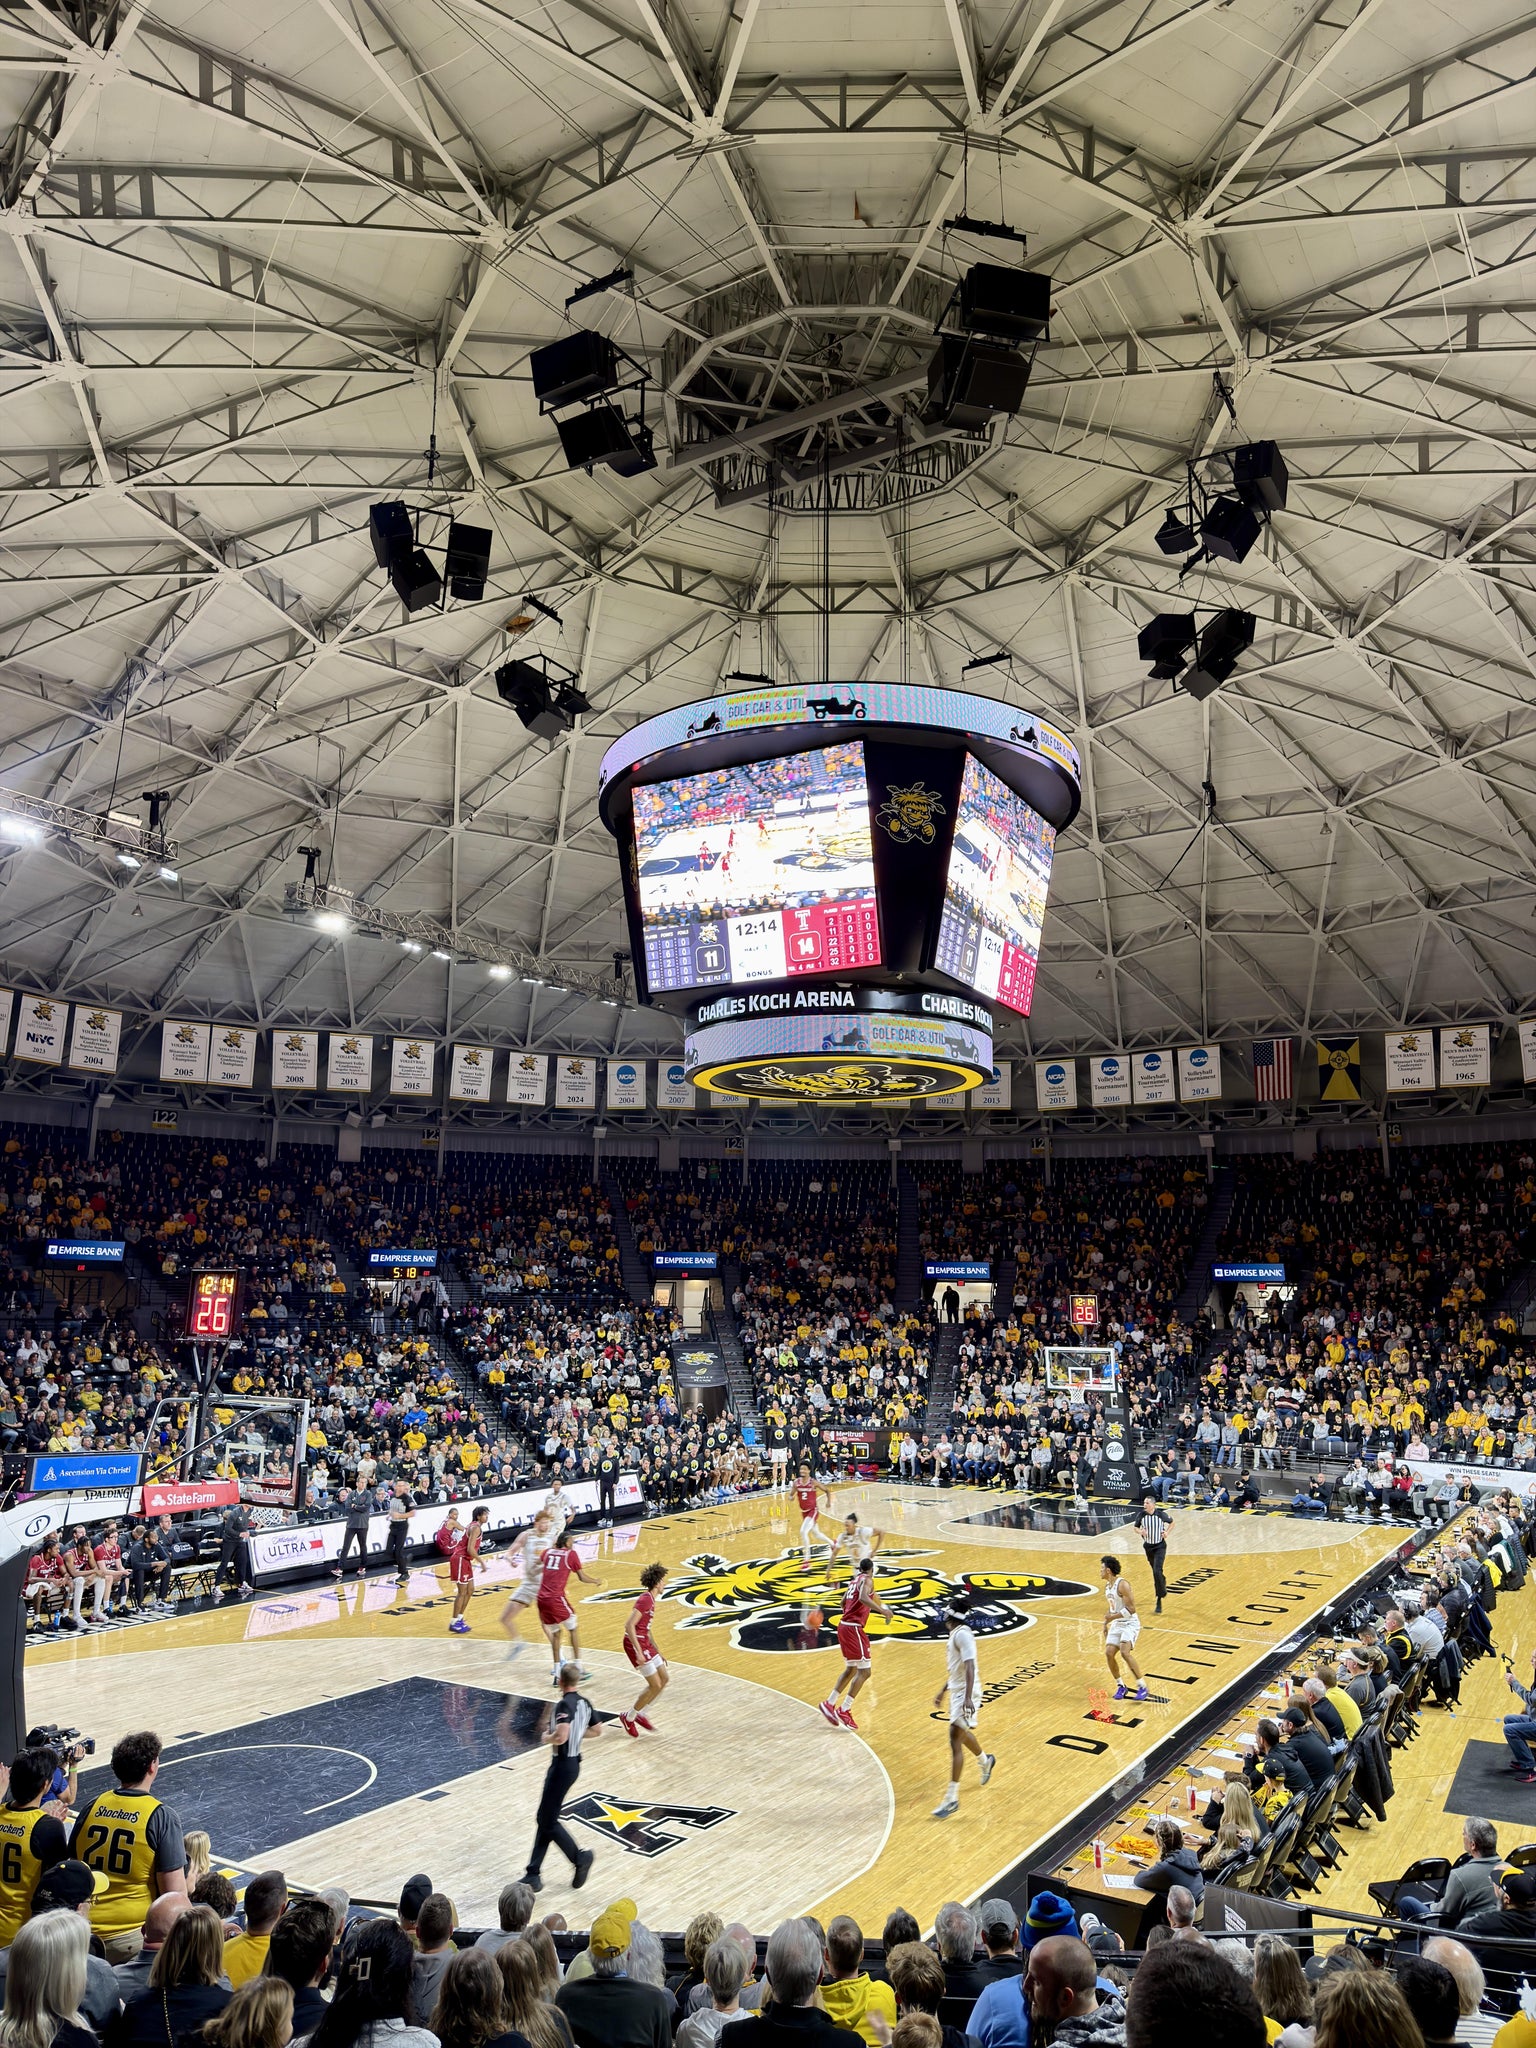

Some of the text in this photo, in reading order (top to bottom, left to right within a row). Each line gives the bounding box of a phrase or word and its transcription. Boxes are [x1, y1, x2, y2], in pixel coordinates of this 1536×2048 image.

[729, 706, 751, 718] GOLF
[752, 701, 771, 714] CAR
[777, 700, 783, 711] &
[828, 911, 870, 926] 2 0 0
[735, 919, 778, 937] 12:14
[848, 924, 853, 933] 0
[866, 921, 871, 930] 0
[828, 937, 838, 946] 22
[848, 934, 854, 944] 5
[867, 932, 872, 941] 0
[829, 942, 873, 956] 25 0 0
[984, 936, 1001, 954] 12:14
[704, 950, 718, 968] 11
[830, 952, 874, 966] 32 4 0
[746, 968, 773, 978] BONUS
[698, 990, 855, 1022] CHARLES KOCH ARENA
[922, 994, 974, 1020] CHARLES
[82, 1028, 111, 1037] VOLLEYBALL
[873, 1027, 896, 1040] GOLF
[898, 1028, 916, 1042] CAR
[918, 1030, 926, 1043] &
[83, 1056, 104, 1066] 2004
[174, 1068, 194, 1076] 2005
[221, 1072, 240, 1080] 2007
[1188, 1069, 1213, 1077] Volleyball
[1455, 1072, 1475, 1080] 1965
[340, 1078, 358, 1086] 2013
[1098, 1075, 1124, 1083] Volleyball
[1402, 1078, 1420, 1086] 1964
[462, 1088, 478, 1096] 2016
[1192, 1088, 1210, 1096] 2024
[154, 1110, 177, 1122] 122
[726, 1138, 744, 1148] 124
[58, 1246, 121, 1256] EMPRISE BANK
[380, 1254, 434, 1262] EMPRISE BANK
[393, 1267, 416, 1278] 5:18
[936, 1266, 966, 1274] EMPRISE
[1224, 1268, 1282, 1277] EMPRISE BANK
[199, 1276, 234, 1294] 12:14
[1076, 1298, 1095, 1306] 12:14
[197, 1298, 228, 1331] 26
[1076, 1306, 1093, 1320] 26
[1107, 1446, 1123, 1454] Pella
[60, 1469, 94, 1477] Ascension
[108, 1466, 132, 1474] Christi
[1449, 1468, 1462, 1476] WIN
[84, 1488, 130, 1502] SPALDING
[802, 1492, 808, 1500] 2
[269, 1542, 308, 1557] ULTRA
[546, 1555, 562, 1570] 11
[1227, 1570, 1334, 1626] COURT
[95, 1805, 140, 1824] Shockers
[0, 1824, 26, 1838] ockers
[83, 1824, 135, 1875] 26
